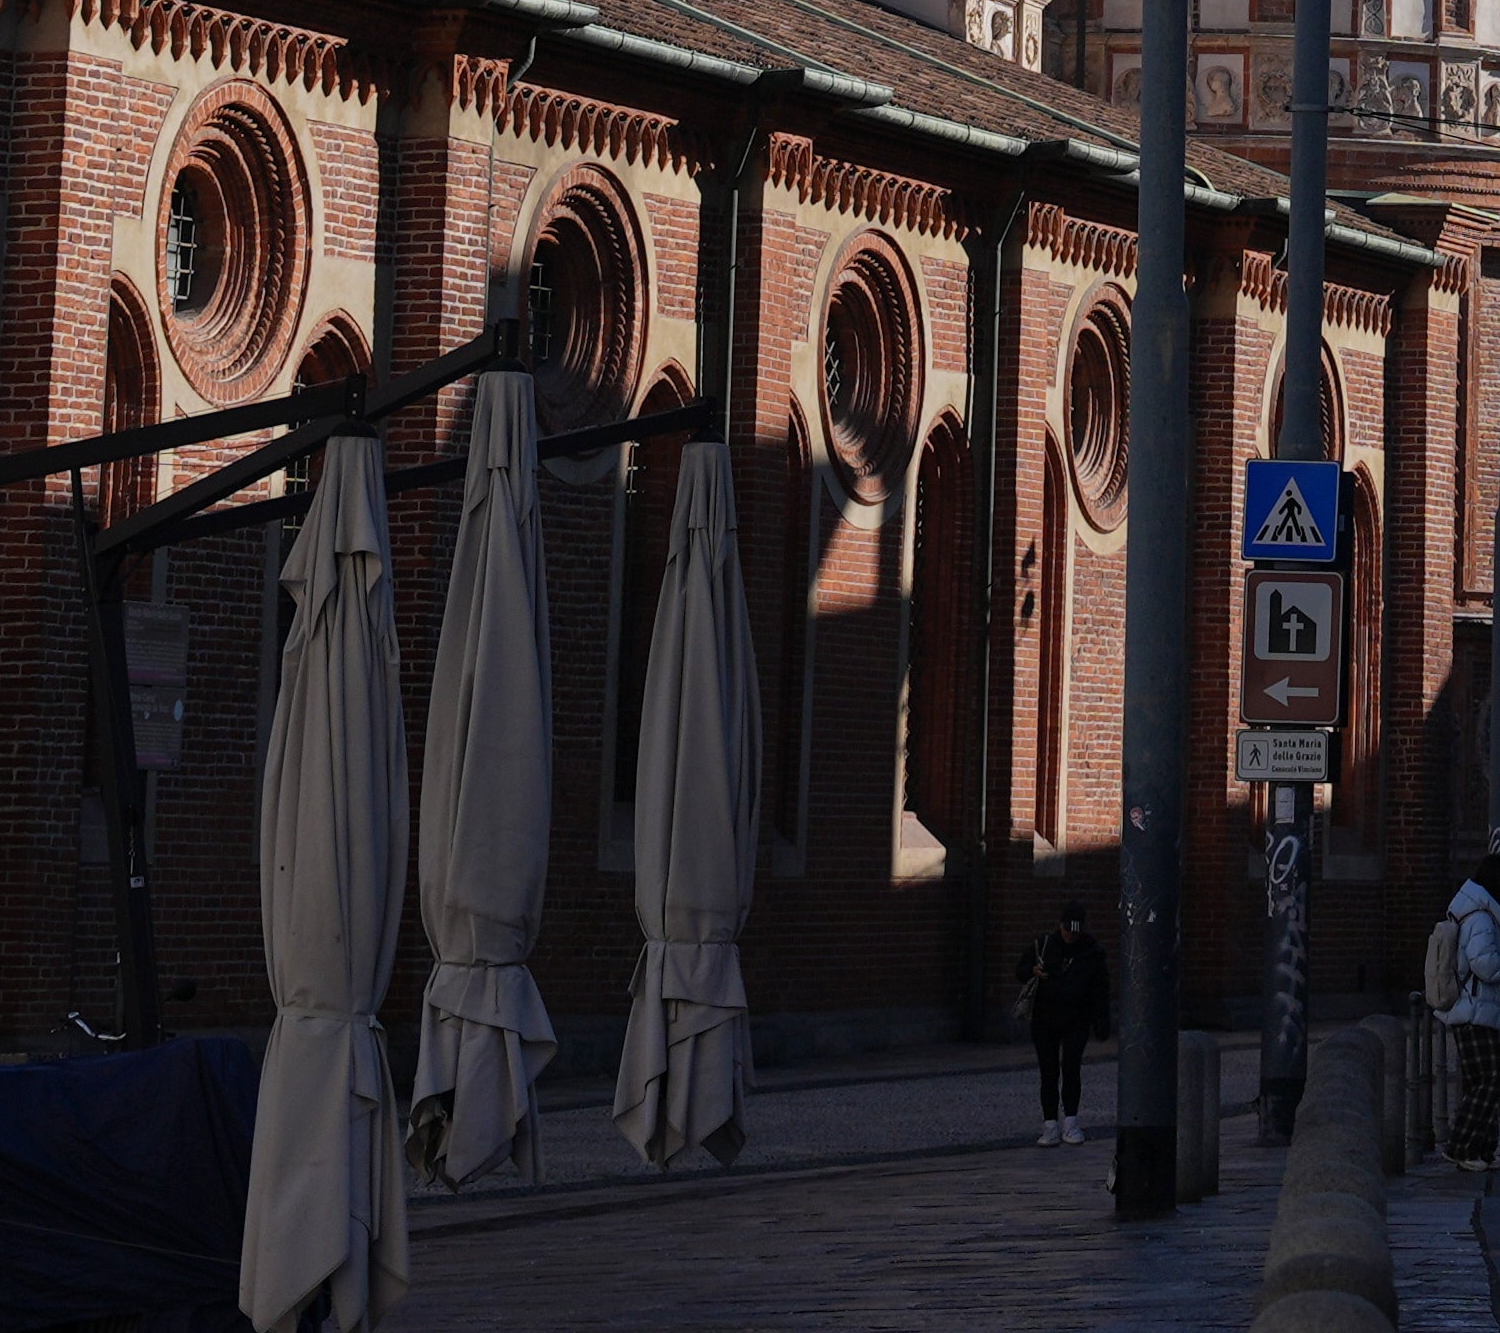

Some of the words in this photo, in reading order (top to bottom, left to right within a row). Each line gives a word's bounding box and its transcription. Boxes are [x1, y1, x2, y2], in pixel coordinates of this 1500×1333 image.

[1273, 738, 1296, 748] Santa
[1299, 738, 1322, 748] Maria
[1272, 751, 1294, 761] delle
[1296, 751, 1322, 761] Grazie
